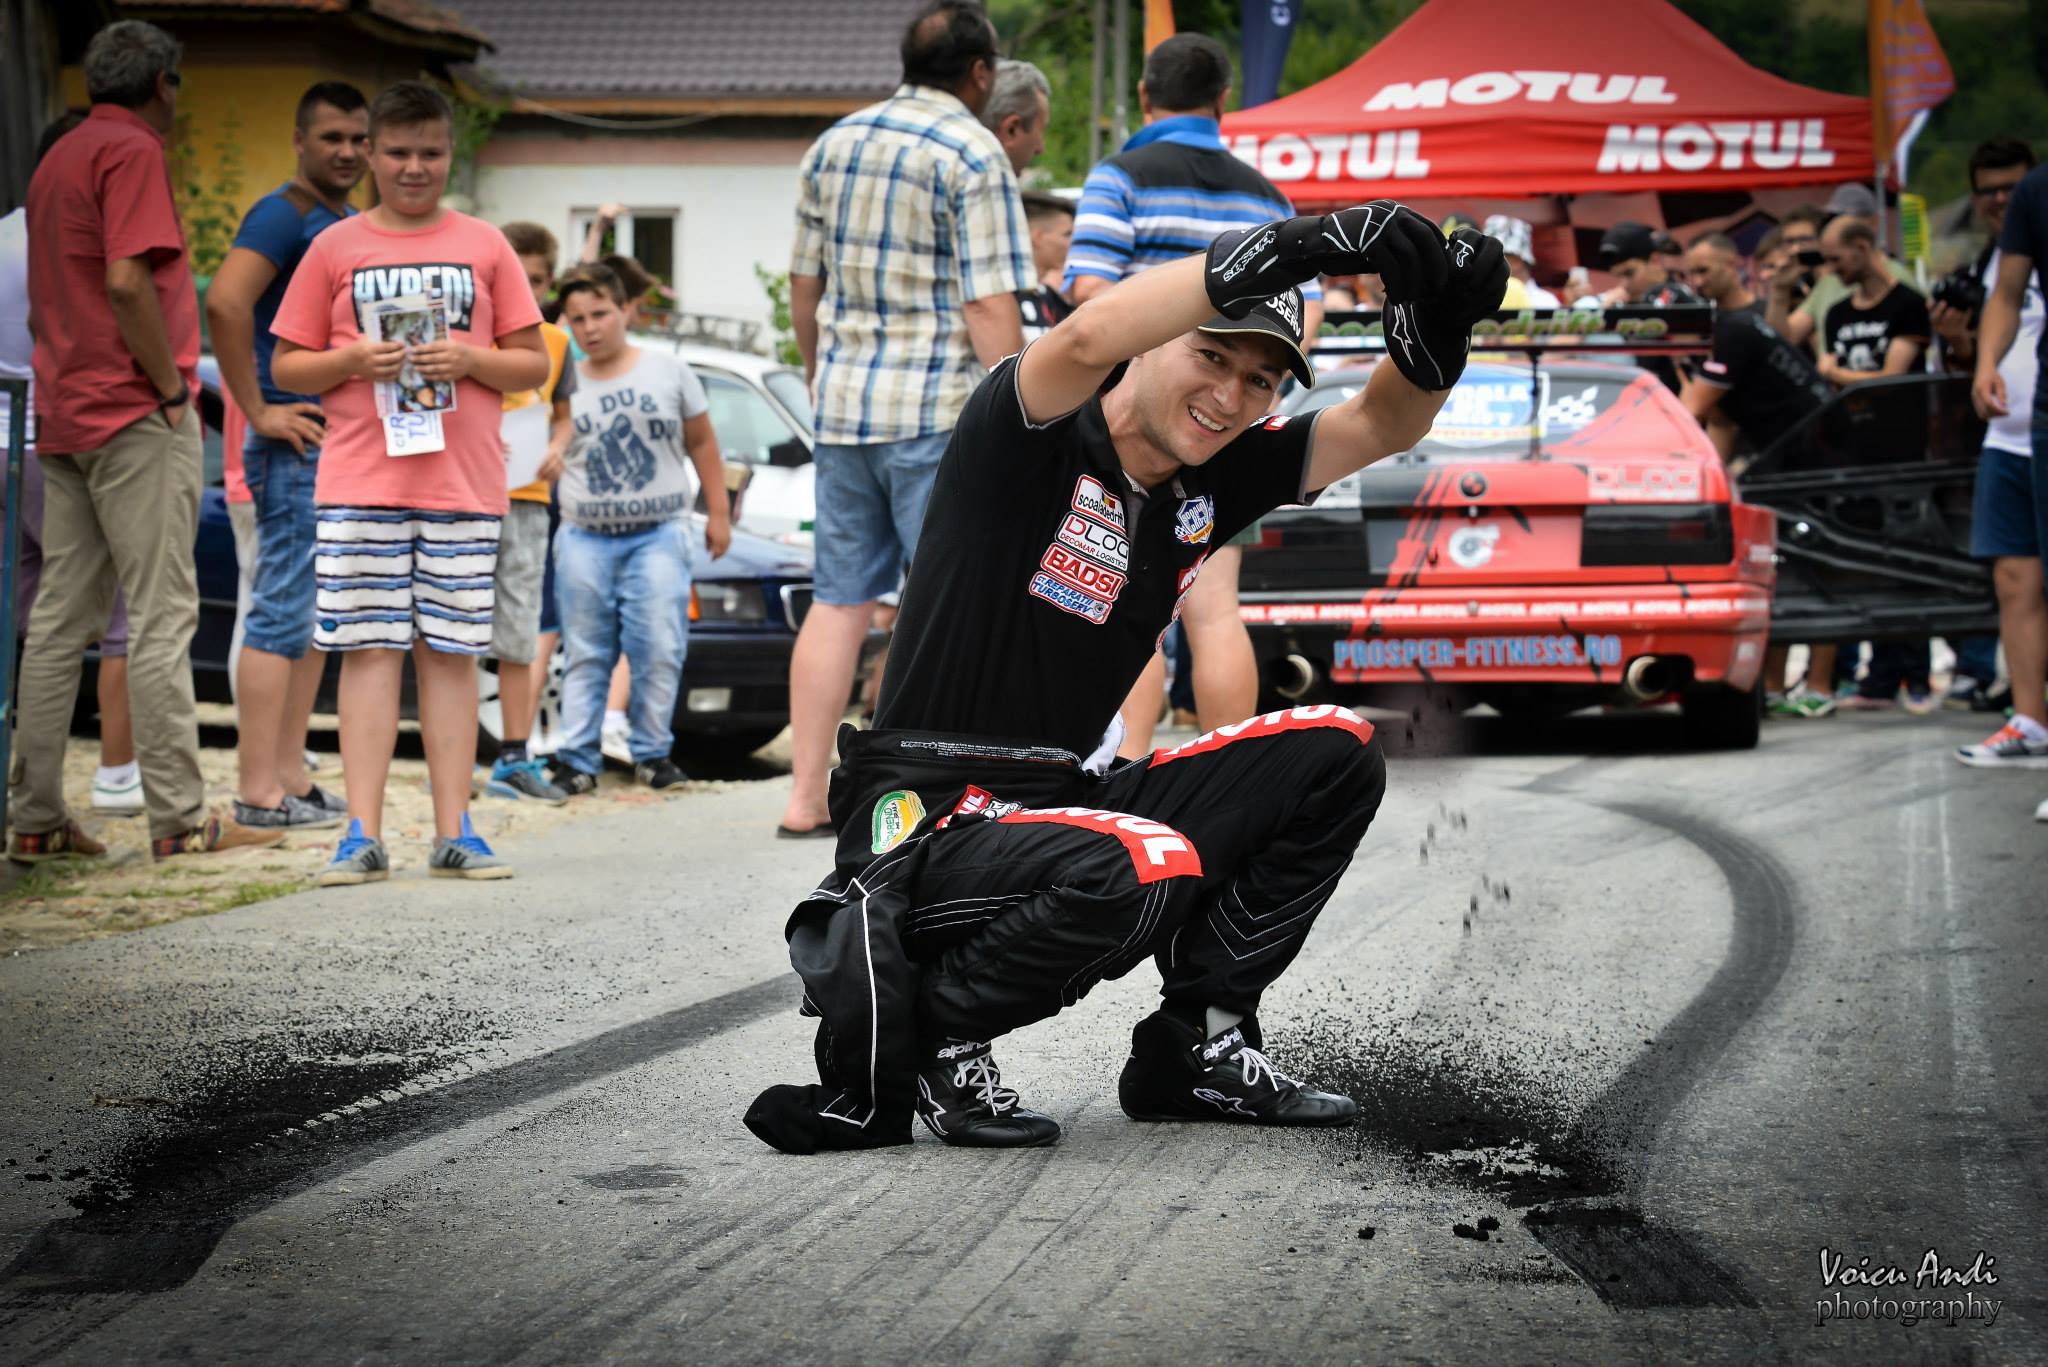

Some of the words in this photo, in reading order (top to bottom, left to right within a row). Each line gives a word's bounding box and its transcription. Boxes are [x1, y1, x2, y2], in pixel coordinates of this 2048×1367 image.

[1362, 70, 1678, 112] MOTUL
[1596, 118, 1836, 173] MOTUL
[1060, 532, 1096, 555] DECOMAR
[1096, 550, 1127, 570] LOGISTICS
[1046, 549, 1121, 597] BADSI
[1032, 581, 1094, 614] TURBOSERV
[1044, 578, 1094, 606] REPARATII
[1333, 635, 1622, 669] PROSPER-FITNESS.RO
[1203, 1030, 1241, 1060] alpine
